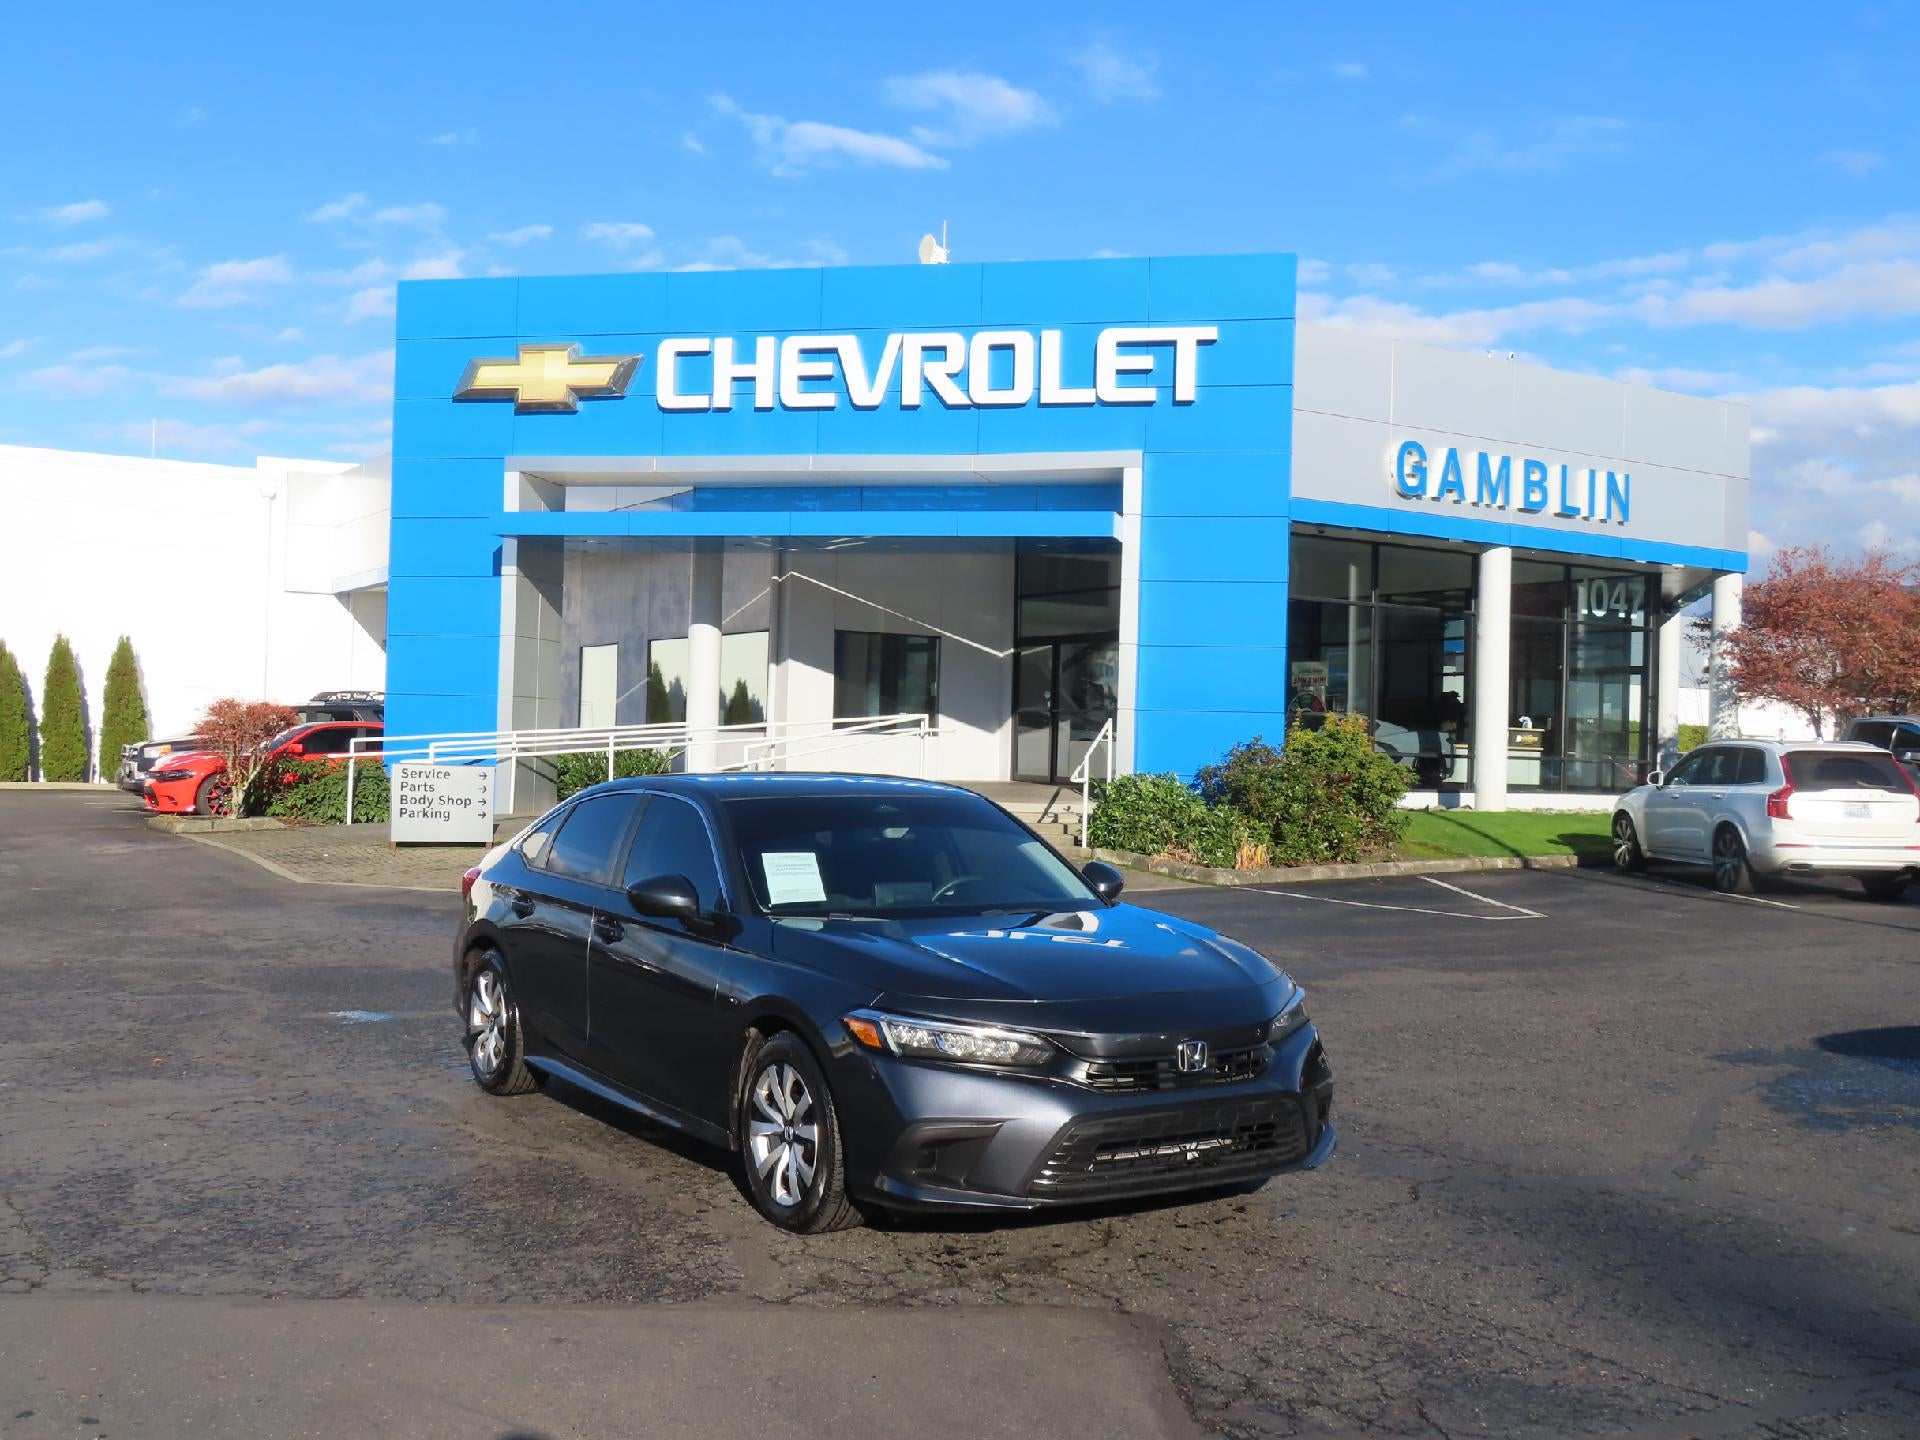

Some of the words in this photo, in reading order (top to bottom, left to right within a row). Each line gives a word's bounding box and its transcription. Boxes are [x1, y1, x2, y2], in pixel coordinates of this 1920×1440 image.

[656, 326, 1218, 410] CHEVROLET
[1396, 440, 1630, 523] GAMBLIN
[1578, 577, 1645, 619] 1047
[401, 768, 451, 779] Service
[400, 782, 435, 792] Parts
[400, 795, 434, 808] Body
[438, 796, 472, 808] Shop
[399, 808, 451, 821] Parking
